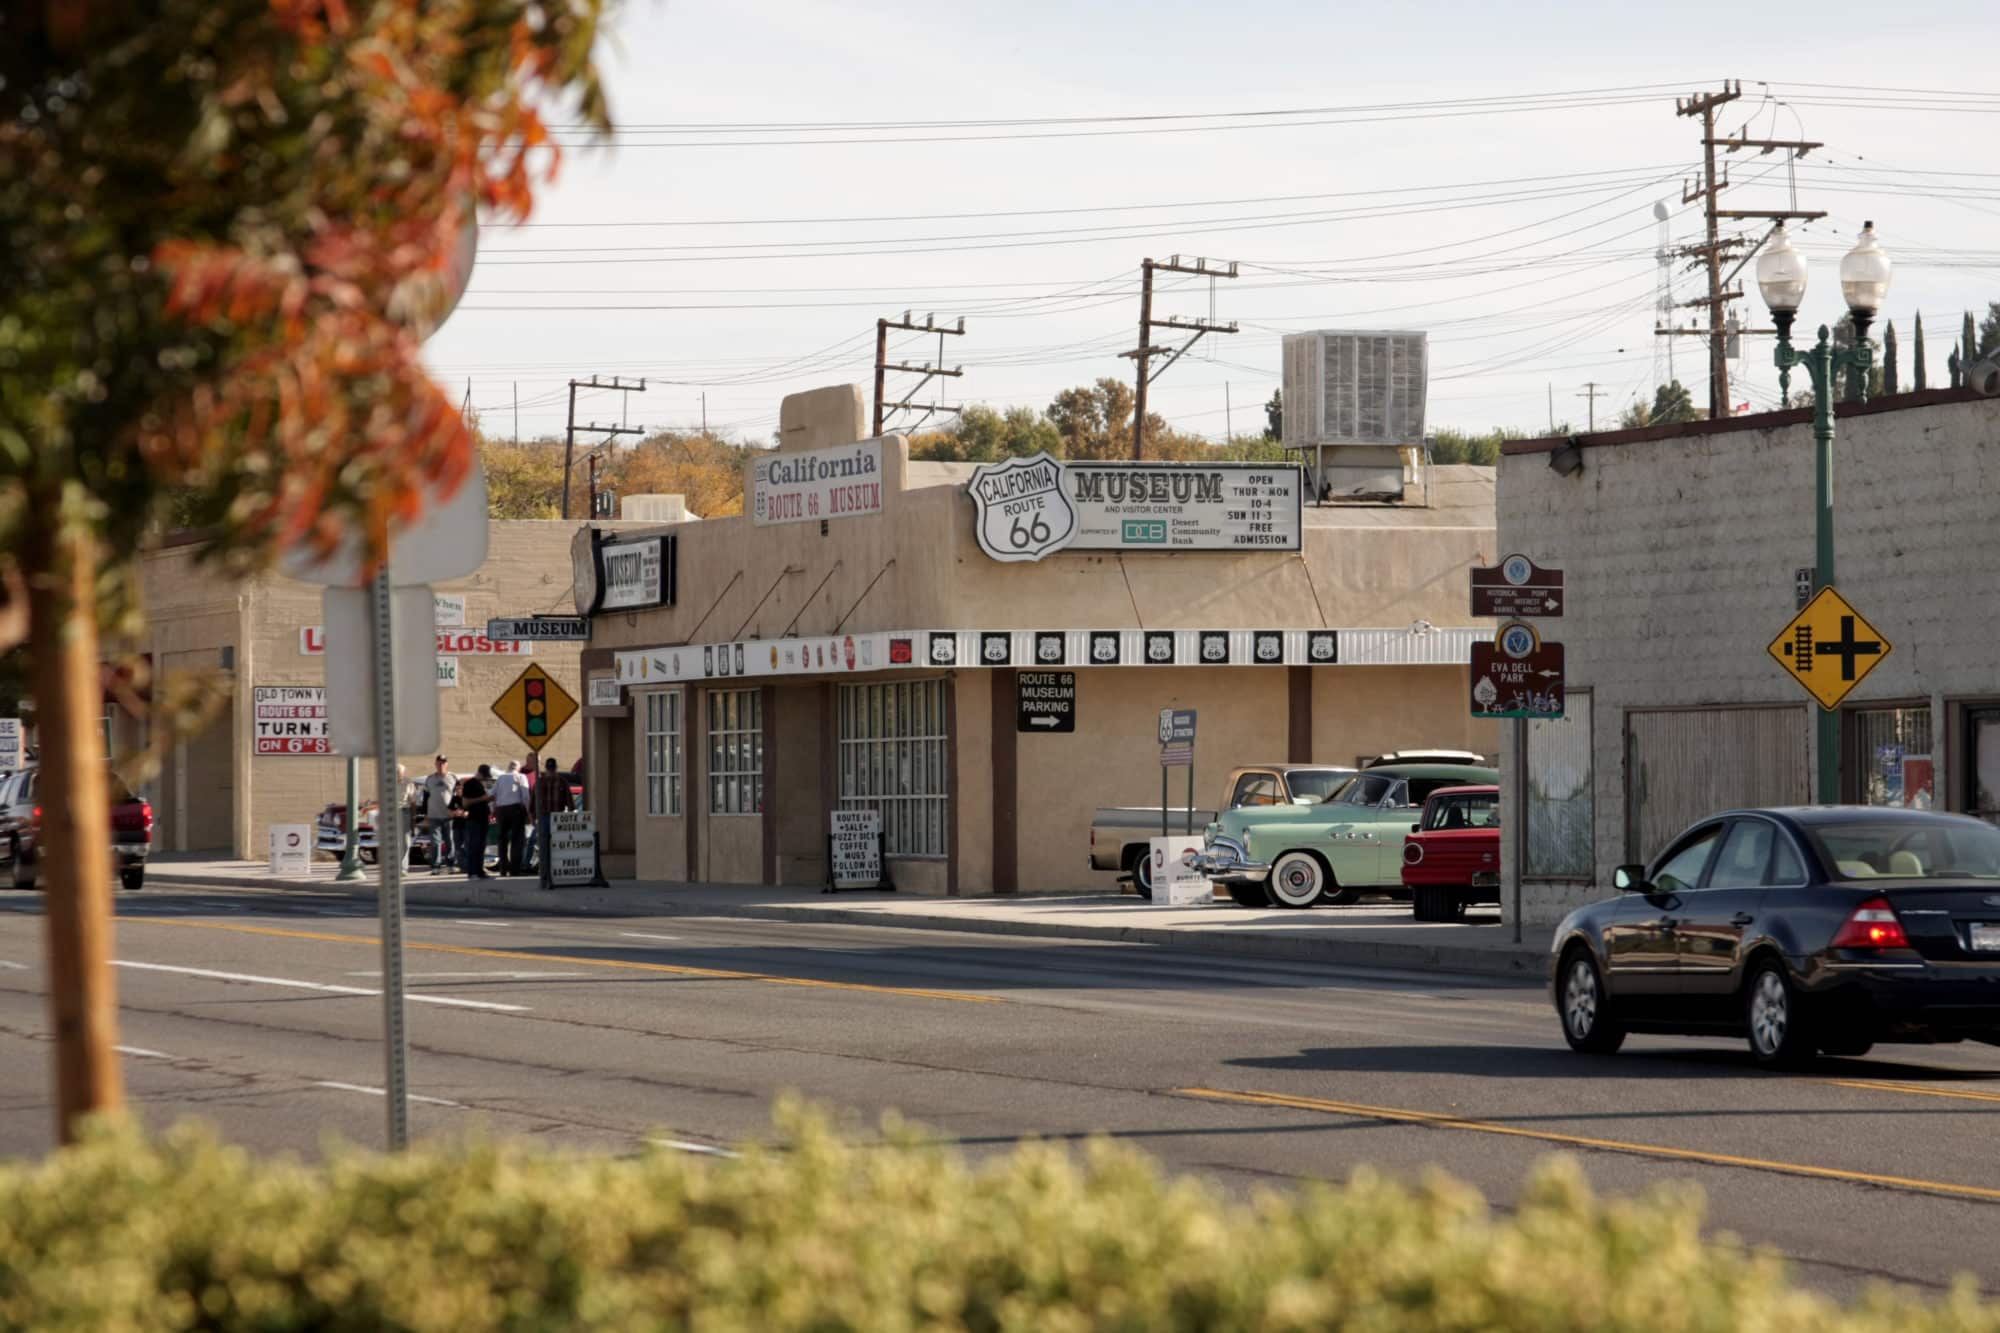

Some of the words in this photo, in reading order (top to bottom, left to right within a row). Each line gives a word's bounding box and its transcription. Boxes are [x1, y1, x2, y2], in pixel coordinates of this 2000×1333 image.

[768, 449, 877, 485] California
[983, 465, 1054, 502] CALIFORNIA
[1248, 475, 1273, 485] OPEN
[1074, 472, 1224, 504] MUSEUM
[1233, 487, 1258, 497] THUR
[1268, 487, 1289, 497] MON
[768, 493, 803, 520] ROUTE
[807, 493, 819, 516] 66
[829, 482, 880, 514] MUSEUM
[1003, 497, 1046, 517] ROUTE
[1104, 506, 1121, 514] AND
[1122, 506, 1150, 514] VISITOR
[1152, 506, 1184, 514] CENTER
[1227, 511, 1246, 520] SUN
[1171, 518, 1199, 526] Desert
[1010, 512, 1051, 548] 66
[1171, 528, 1221, 537] Community
[1249, 523, 1273, 533] FREE
[1171, 537, 1194, 545] Bank
[1233, 535, 1288, 545] ADMISSION
[513, 622, 587, 636] MUSEUM
[936, 650, 949, 658] 66
[989, 650, 1002, 658] 66
[1043, 650, 1057, 658] 66
[1098, 650, 1111, 658] 66
[1491, 663, 1508, 673] EVA
[1512, 663, 1533, 673] DELL
[1019, 674, 1055, 685] ROUTE
[1060, 674, 1073, 685] 66
[1500, 673, 1524, 683] PARK
[256, 688, 277, 702] OLD
[281, 688, 313, 702] TOWN
[1022, 688, 1073, 698] MUSEUM
[260, 706, 297, 718] ROUTE
[298, 706, 312, 718] 66
[1022, 702, 1069, 712] PARKING
[260, 740, 281, 751] ON
[836, 813, 861, 823] ROUTE
[845, 823, 863, 832] SALE
[840, 841, 868, 850] COFFEE
[844, 851, 866, 860] MUGS
[832, 861, 866, 870] FOLLOW
[867, 861, 879, 869] US
[846, 870, 880, 879] TWITTER
